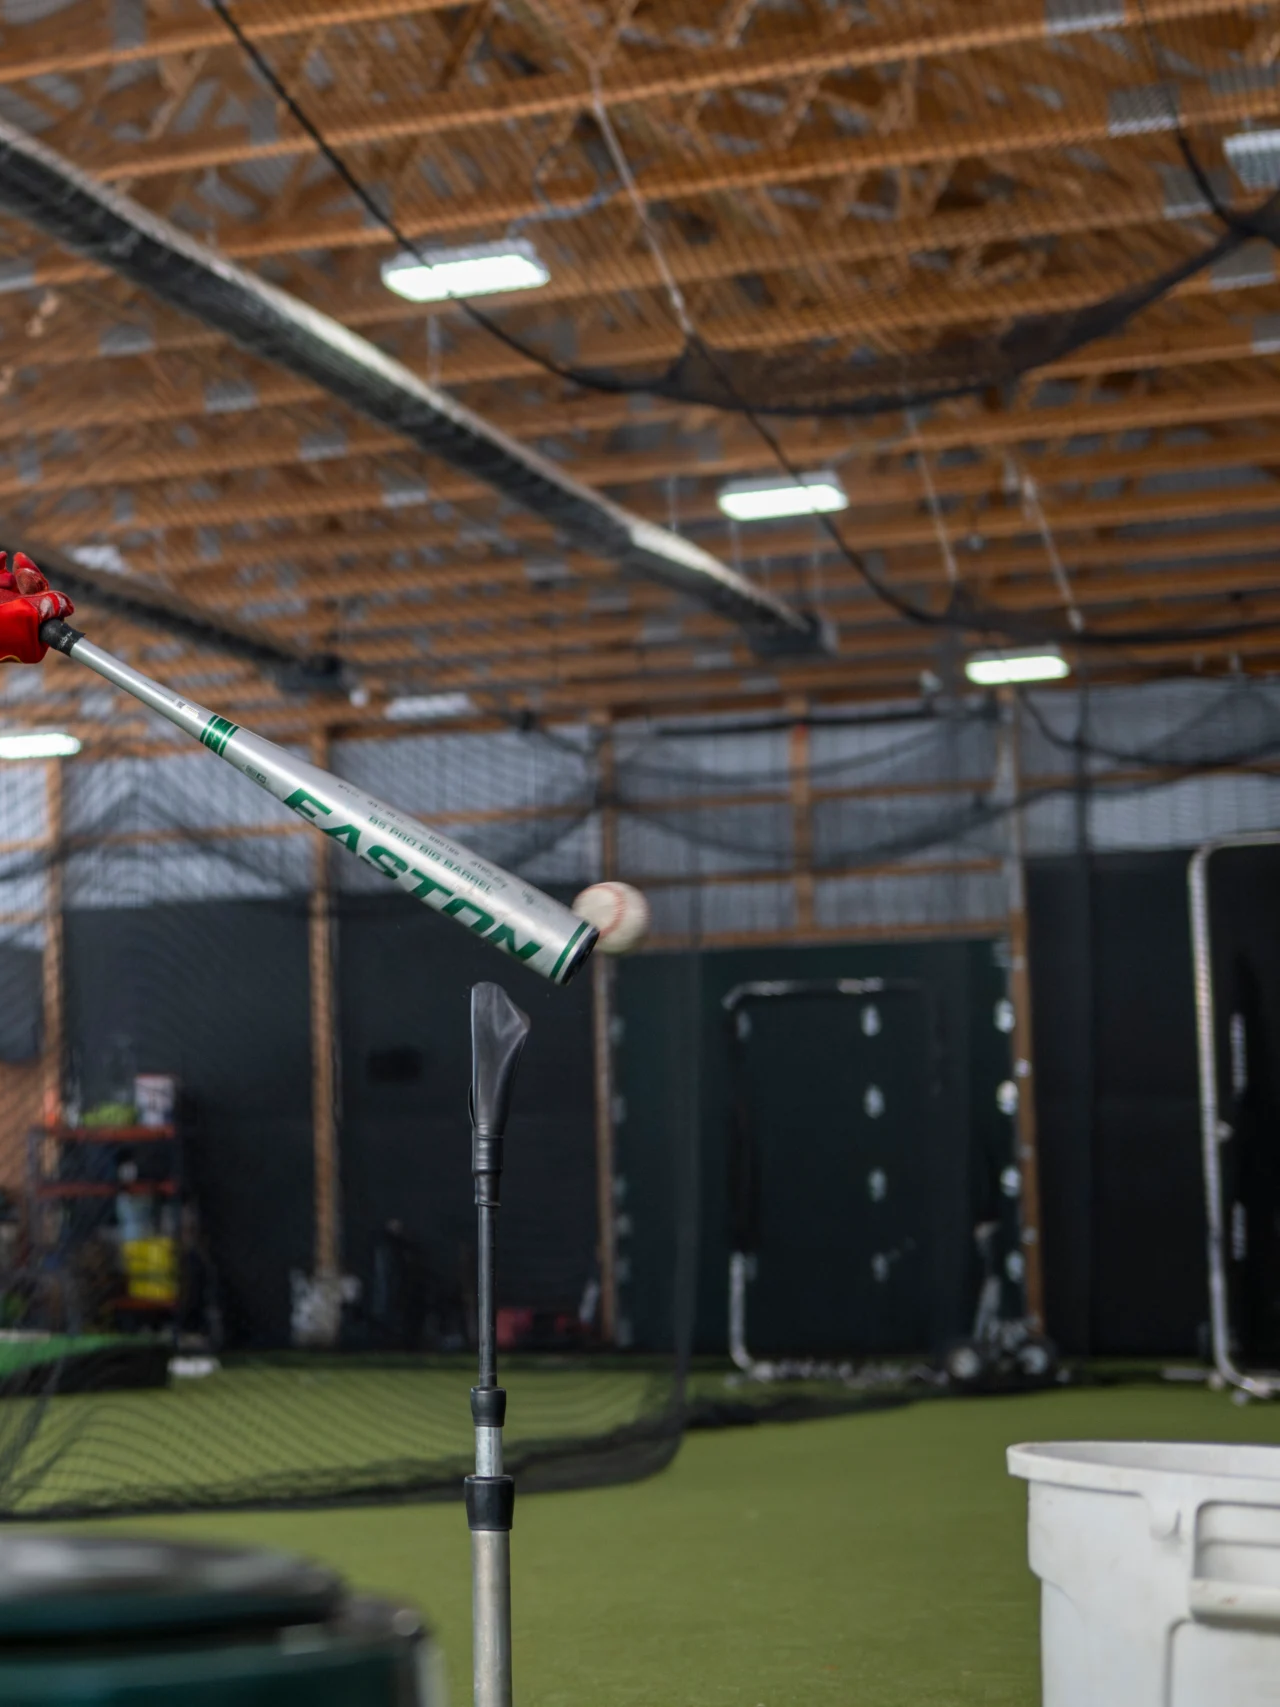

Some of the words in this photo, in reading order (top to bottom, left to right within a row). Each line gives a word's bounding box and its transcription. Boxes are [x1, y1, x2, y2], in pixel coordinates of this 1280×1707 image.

[284, 788, 542, 961] EASTON
[389, 827, 417, 847] PRO
[419, 844, 442, 861] BIG
[443, 858, 492, 892] BARREL
